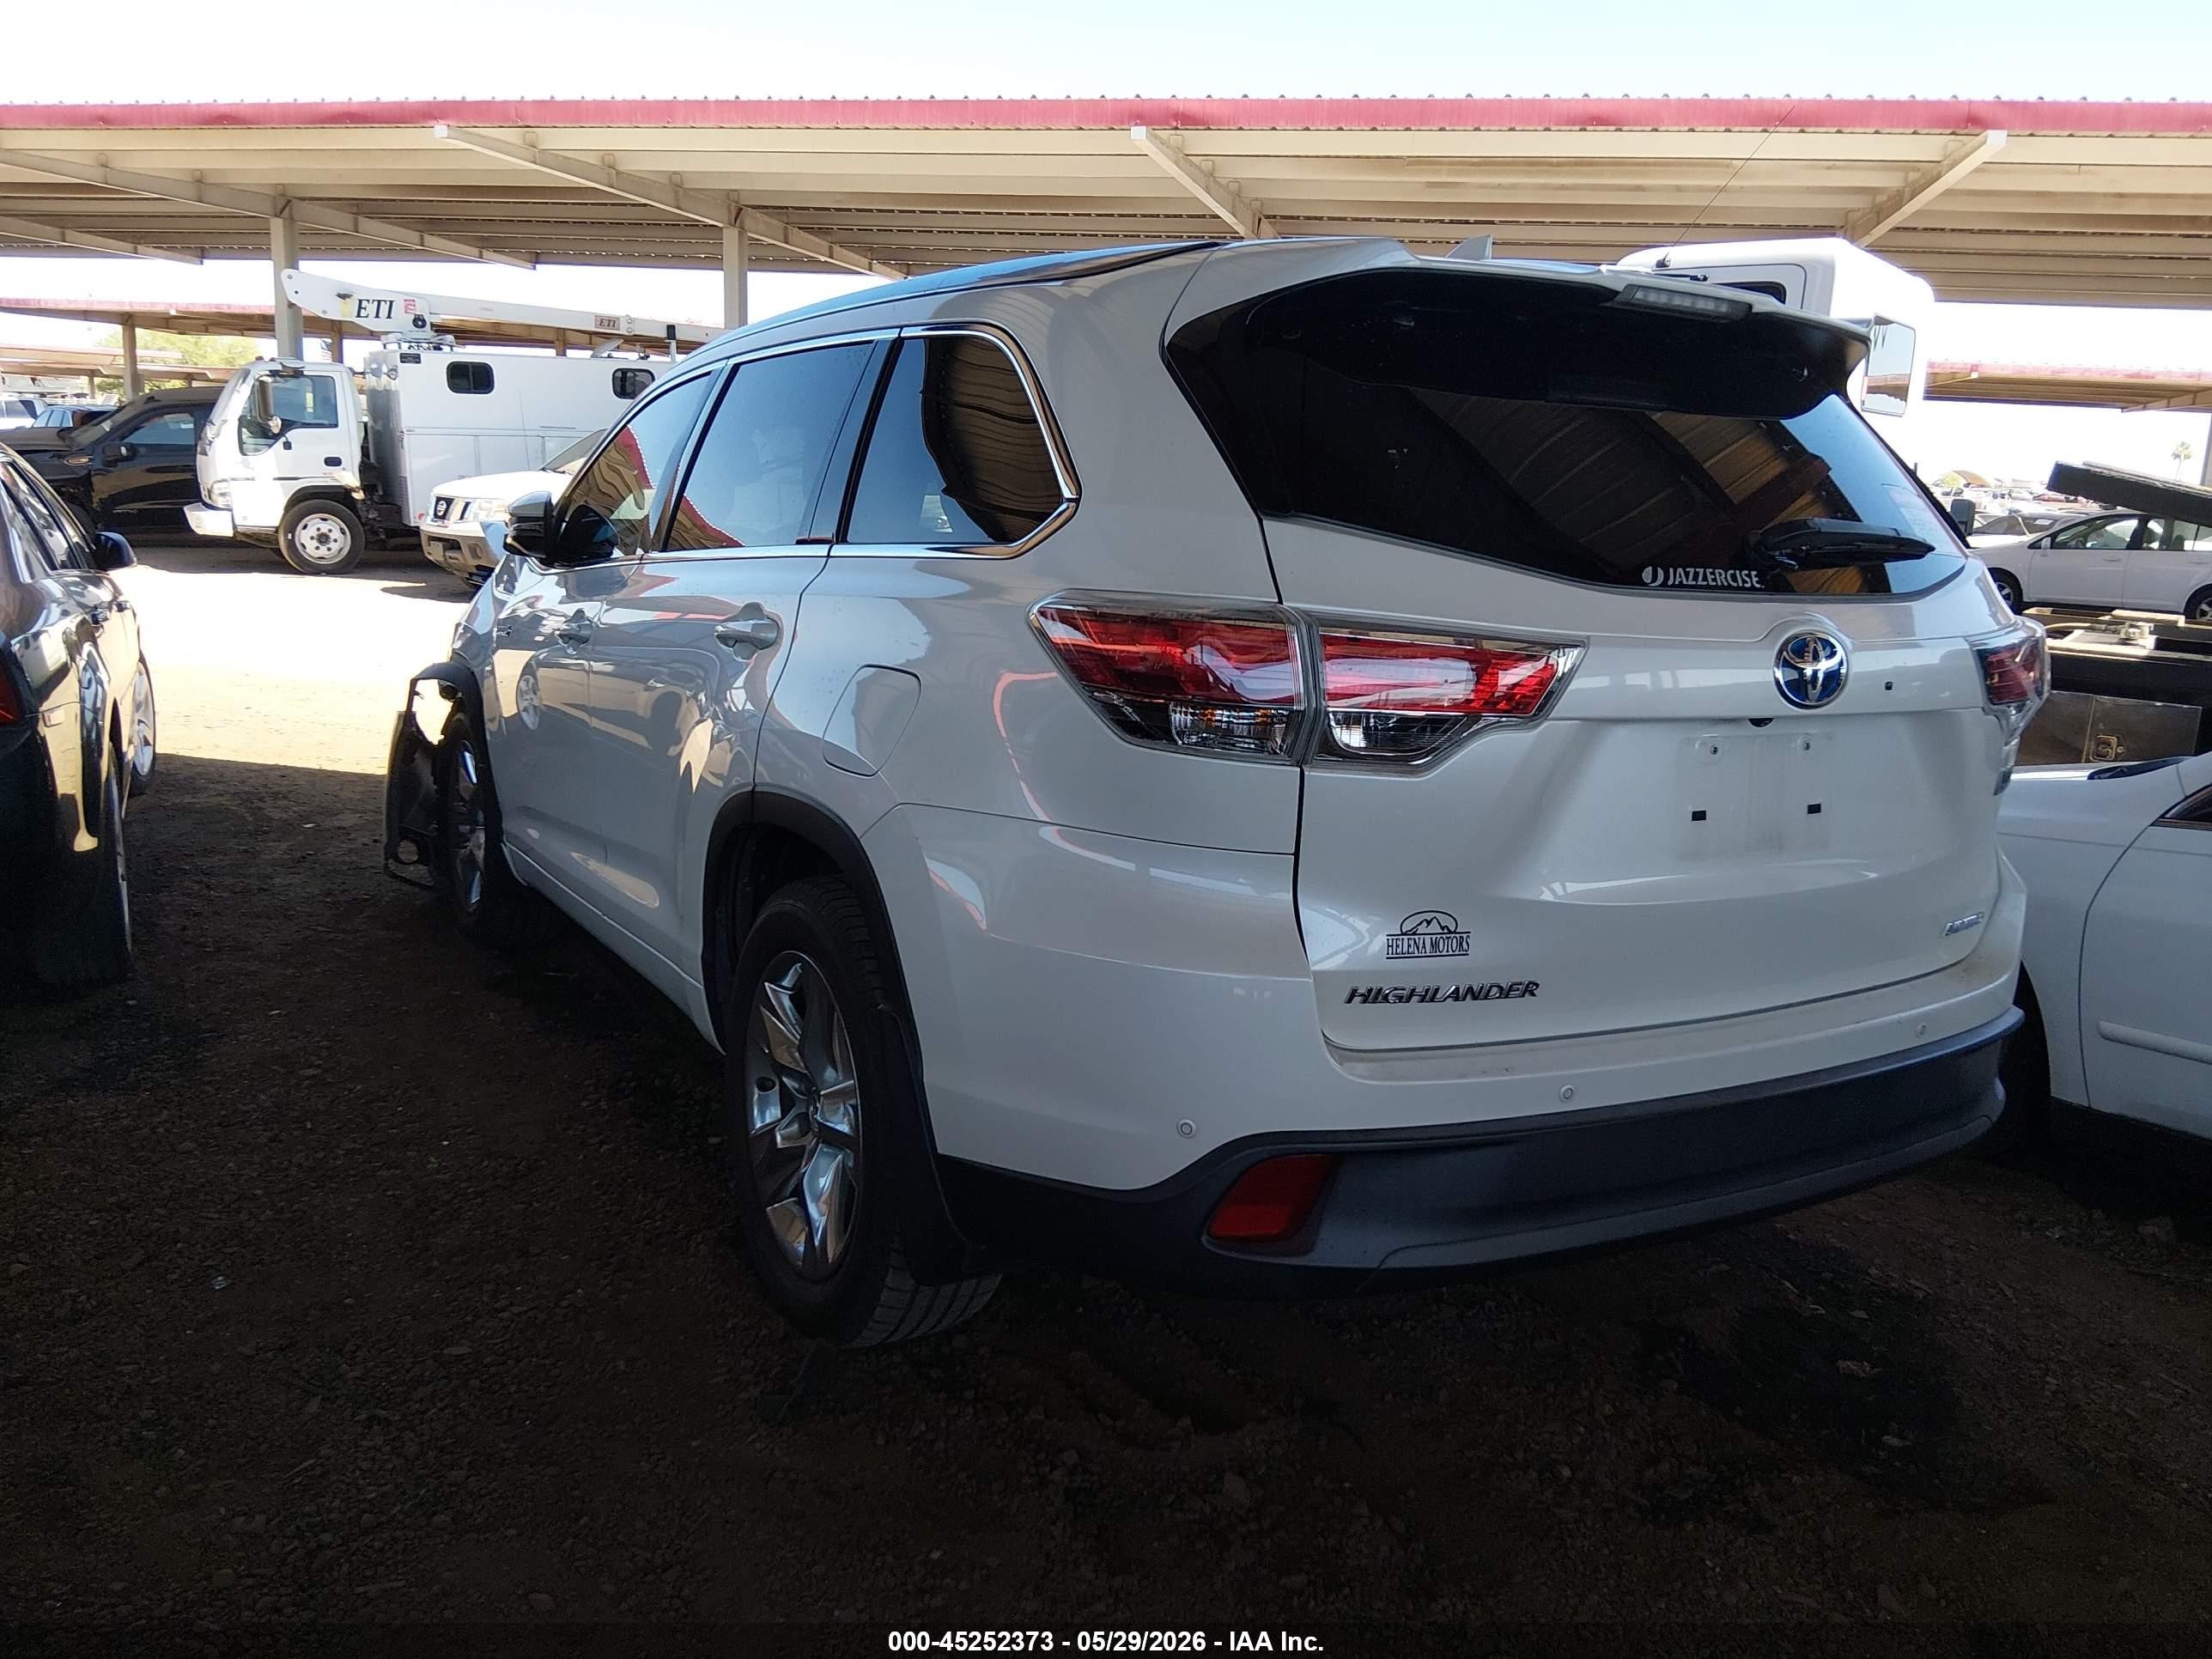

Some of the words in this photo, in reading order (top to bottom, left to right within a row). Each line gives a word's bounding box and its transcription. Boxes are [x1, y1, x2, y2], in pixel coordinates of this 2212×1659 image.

[356, 299, 395, 319] ETI
[599, 318, 617, 328] ETI
[1668, 568, 1761, 588] JAZZERCISE
[1386, 937, 1426, 955] HELENA
[1430, 935, 1470, 954] MOTORS
[1344, 980, 1540, 1004] HIGHLANDER
